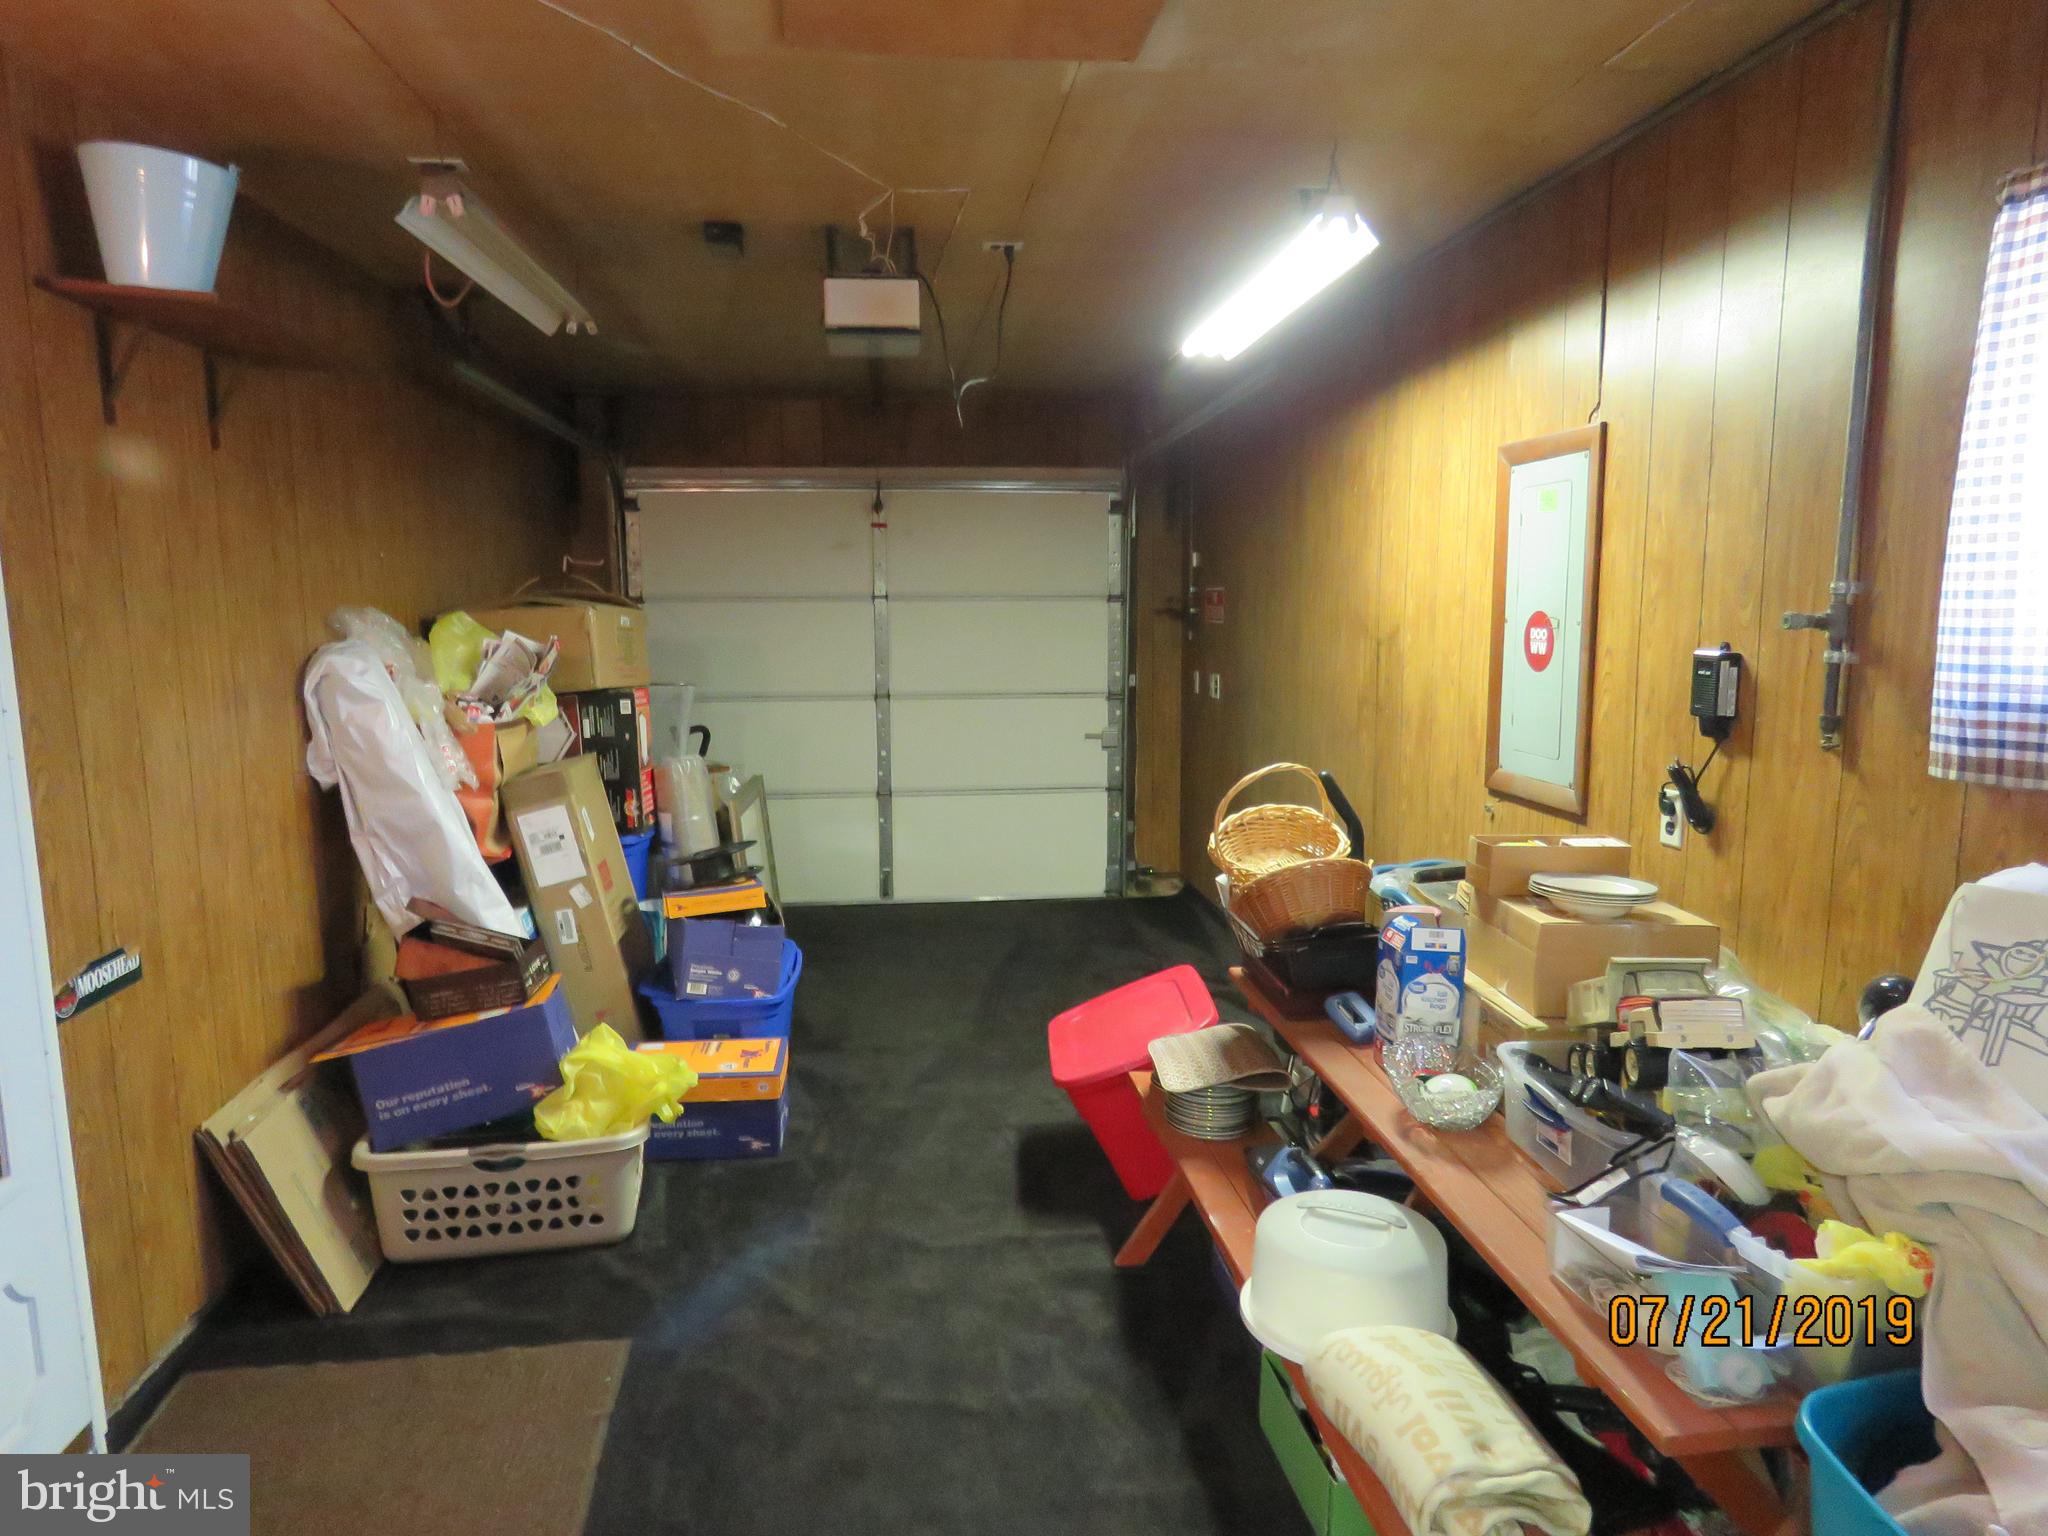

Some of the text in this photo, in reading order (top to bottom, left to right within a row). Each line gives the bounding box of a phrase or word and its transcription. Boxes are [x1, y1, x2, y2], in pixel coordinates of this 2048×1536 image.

[75, 954, 140, 998] MOOSEHEAD
[375, 1078, 471, 1111] Our reputation
[378, 1110, 391, 1121] is
[394, 1106, 411, 1118] on
[412, 1095, 449, 1113] every
[652, 1119, 704, 1130] eputation
